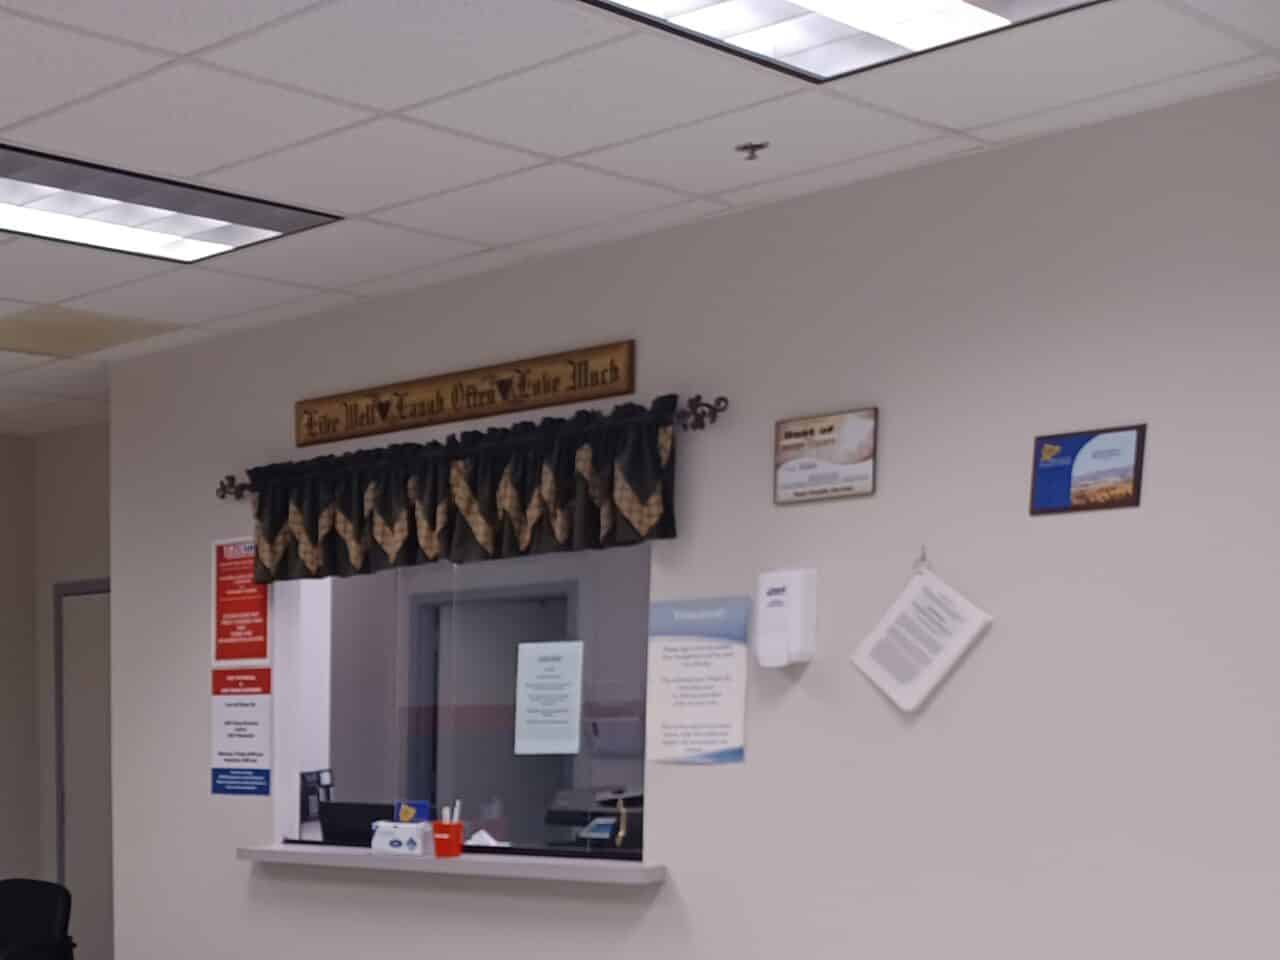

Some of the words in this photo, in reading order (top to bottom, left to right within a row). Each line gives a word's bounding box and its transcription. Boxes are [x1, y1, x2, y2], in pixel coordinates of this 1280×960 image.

[341, 399, 376, 432] Well
[451, 377, 496, 409] Often
[568, 358, 620, 391] Much
